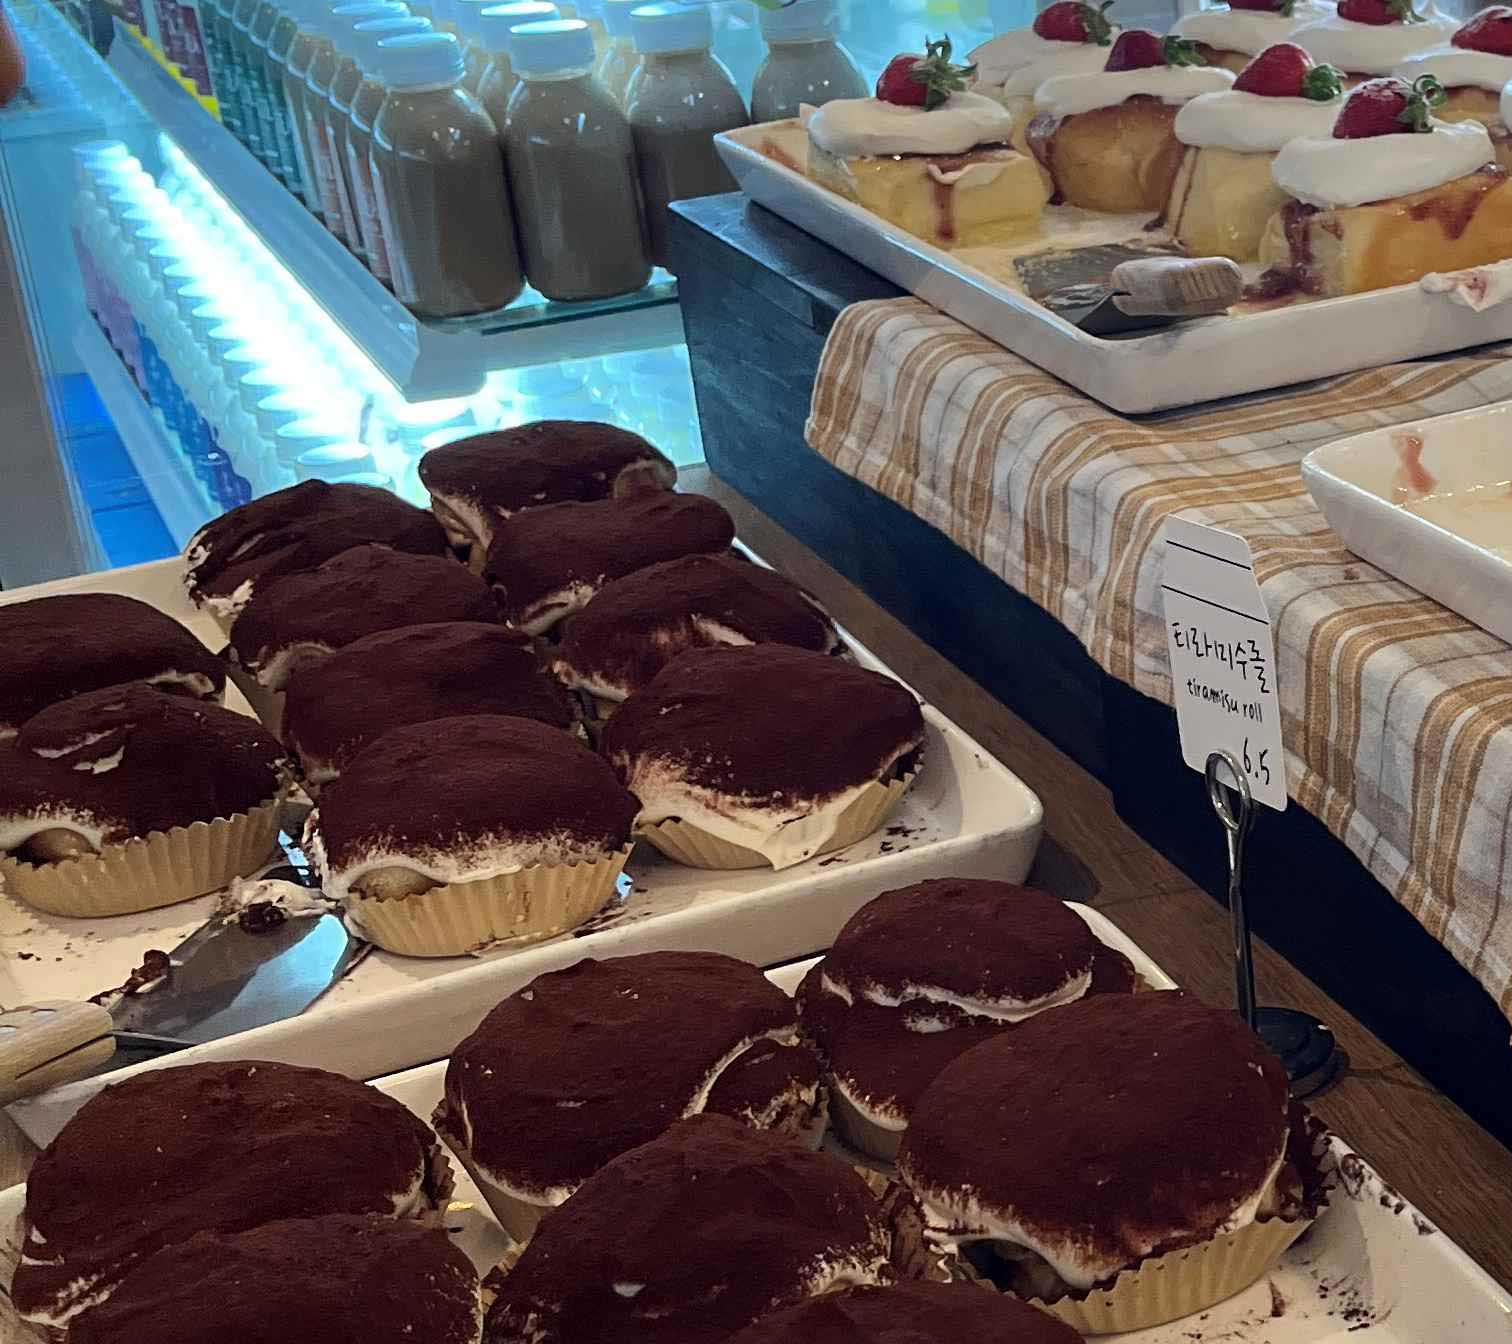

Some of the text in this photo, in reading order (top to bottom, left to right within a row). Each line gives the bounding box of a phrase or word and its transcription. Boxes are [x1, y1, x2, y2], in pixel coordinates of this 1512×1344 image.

[1171, 622, 1270, 694] 티라미수롤
[1186, 677, 1264, 723] tiramisu roll
[1243, 737, 1270, 785] 6.5
